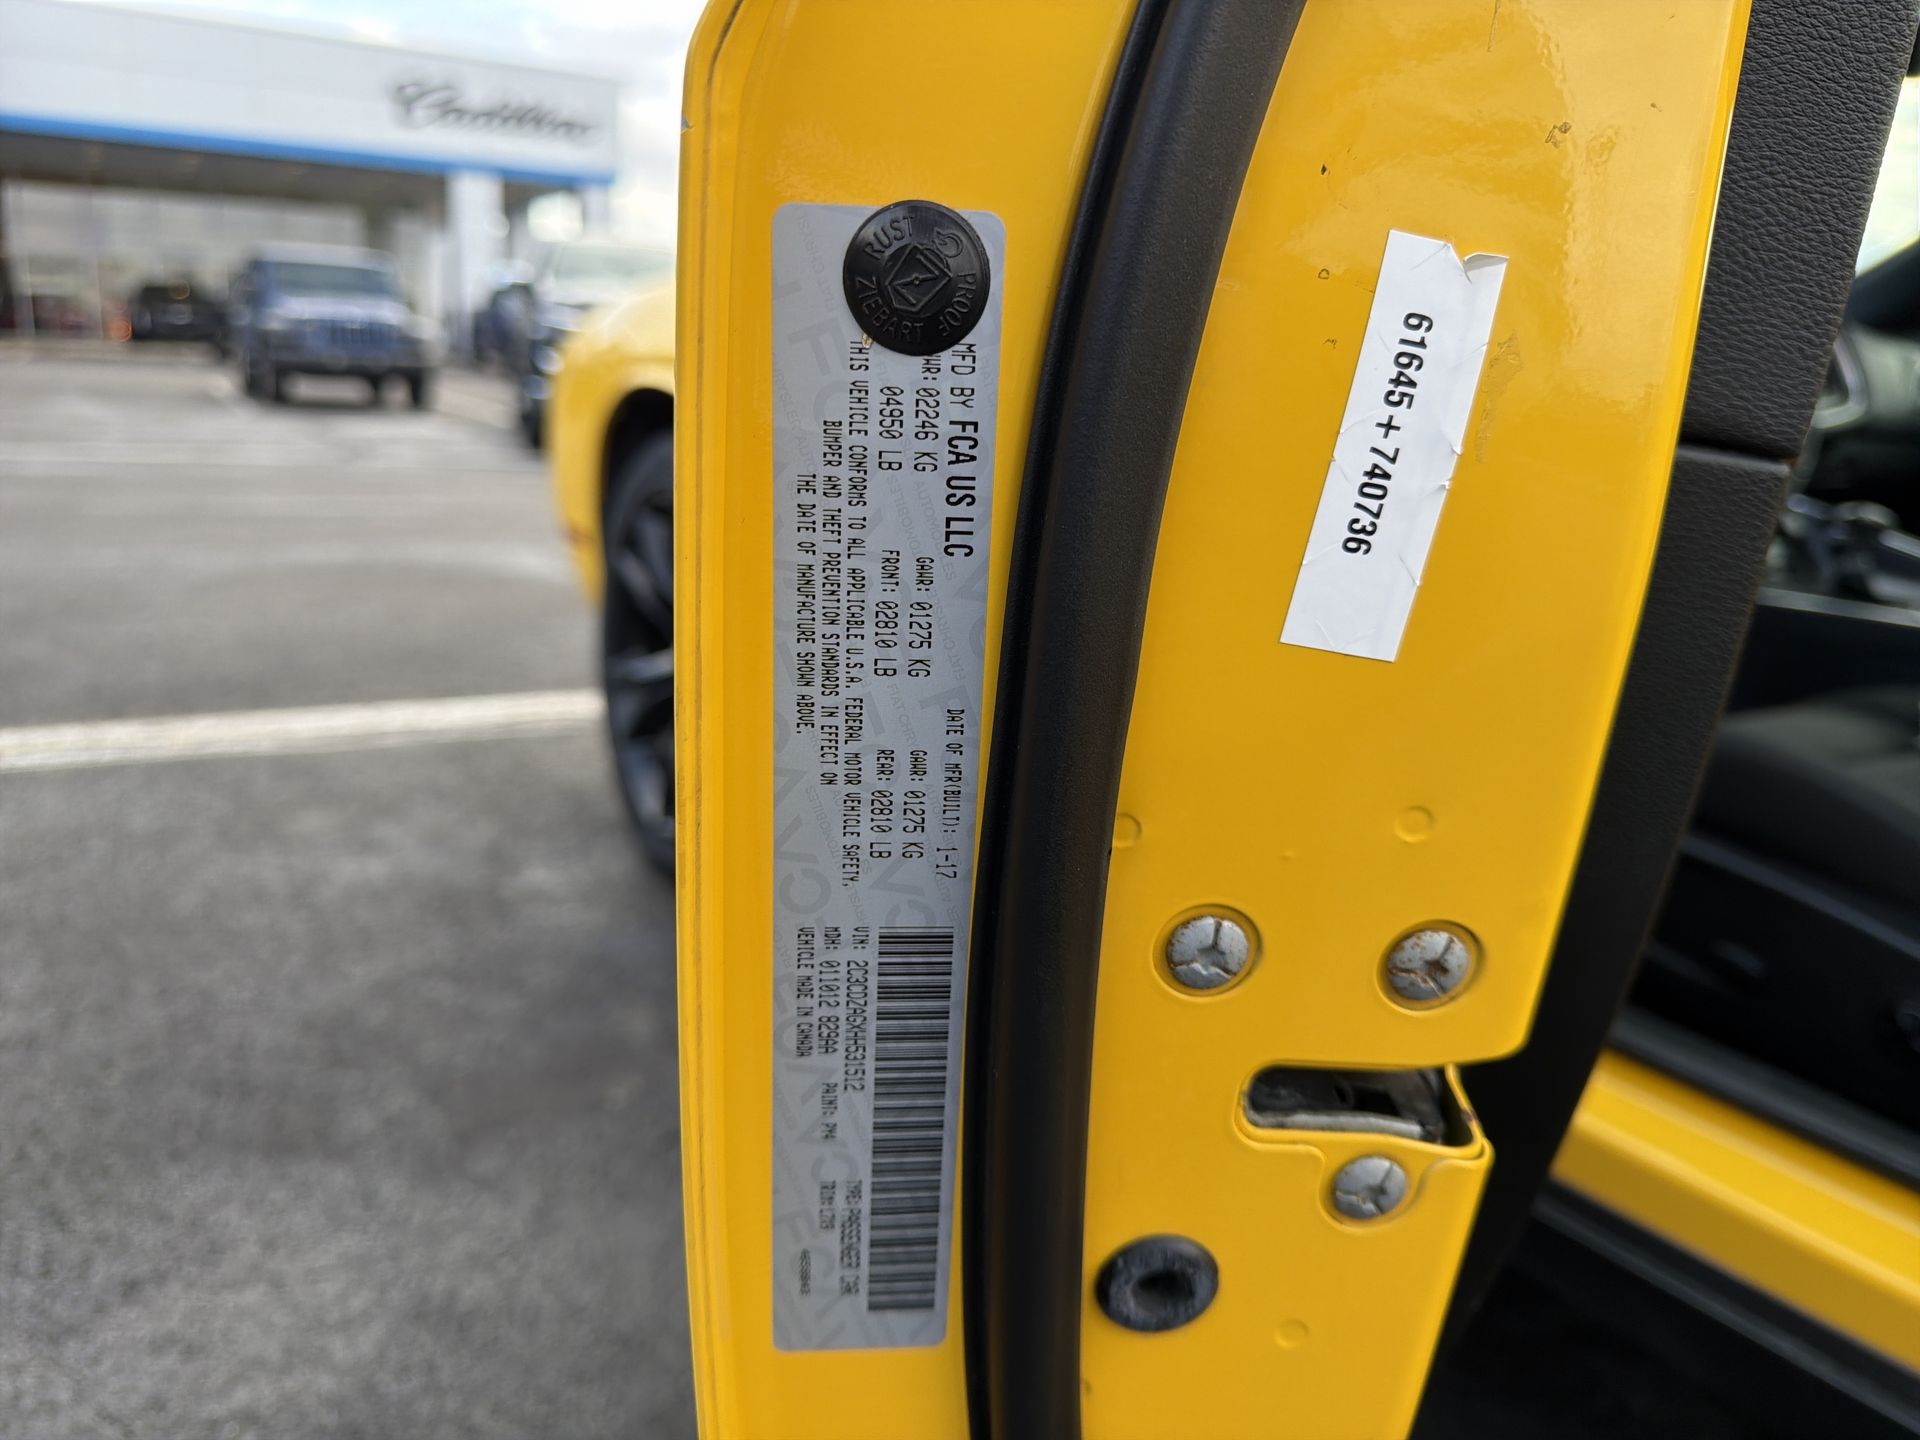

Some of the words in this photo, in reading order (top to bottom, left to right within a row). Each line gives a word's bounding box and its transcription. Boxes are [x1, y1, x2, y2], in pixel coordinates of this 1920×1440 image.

[856, 274, 923, 342] ZIEBART
[950, 343, 977, 376] MFD
[1382, 312, 1433, 410] 61645
[849, 381, 868, 436] VEHICLE
[879, 387, 904, 439] 04950
[915, 388, 940, 440] 02246
[950, 387, 974, 408] BY
[823, 421, 842, 466] BUMPER
[948, 421, 978, 465] FCA
[848, 446, 867, 506] CONFORMS
[879, 451, 902, 470] LB
[914, 452, 937, 472] KG
[797, 474, 816, 494] THE
[823, 476, 841, 498] AND
[946, 476, 976, 506] US
[1342, 446, 1400, 556] 740736
[797, 504, 816, 533] DATE
[823, 509, 841, 543] THEFT
[848, 517, 866, 529] TO
[798, 542, 816, 555] OF
[847, 538, 865, 559] ALL
[944, 517, 974, 557] LLC
[881, 550, 900, 591] FRONT:
[916, 557, 934, 591] GAWR:
[797, 564, 815, 643] MANUFACTURE
[822, 553, 841, 625] PREVENTION
[846, 568, 865, 640] APPLICABLE
[875, 601, 898, 648] 02810
[909, 602, 932, 648] 01275
[797, 652, 815, 686] SHOWN
[821, 634, 840, 696] STANDARDS
[846, 649, 864, 688] U.S.A.
[874, 659, 897, 676] LB
[908, 660, 930, 677] KG
[797, 695, 814, 733] ABOVE.
[821, 706, 839, 717] IN
[845, 698, 863, 744] FEDERAL
[946, 709, 964, 735] DATE
[821, 725, 838, 764] EFFECT
[946, 743, 963, 755] OF
[821, 773, 837, 785] ON
[844, 753, 861, 785] MOTOR
[877, 750, 894, 780] REAR:
[910, 750, 927, 781] GAWR:
[843, 793, 861, 837] VEHICLE
[871, 790, 893, 832] 02810
[903, 791, 925, 833] 01275
[943, 764, 962, 832] MFR(BUILT):
[870, 843, 891, 858] LB
[902, 843, 923, 858] KG
[936, 848, 957, 878] 1-17
[797, 927, 814, 968] VEHICLE
[825, 927, 841, 949] MDH:
[852, 927, 869, 949] VIN:
[797, 976, 813, 998] MADE
[819, 961, 840, 1007] 011012
[797, 1007, 813, 1016] IN
[797, 1023, 813, 1056] CANADA
[818, 1016, 839, 1053] 829AA
[822, 1083, 837, 1115] PAINT:
